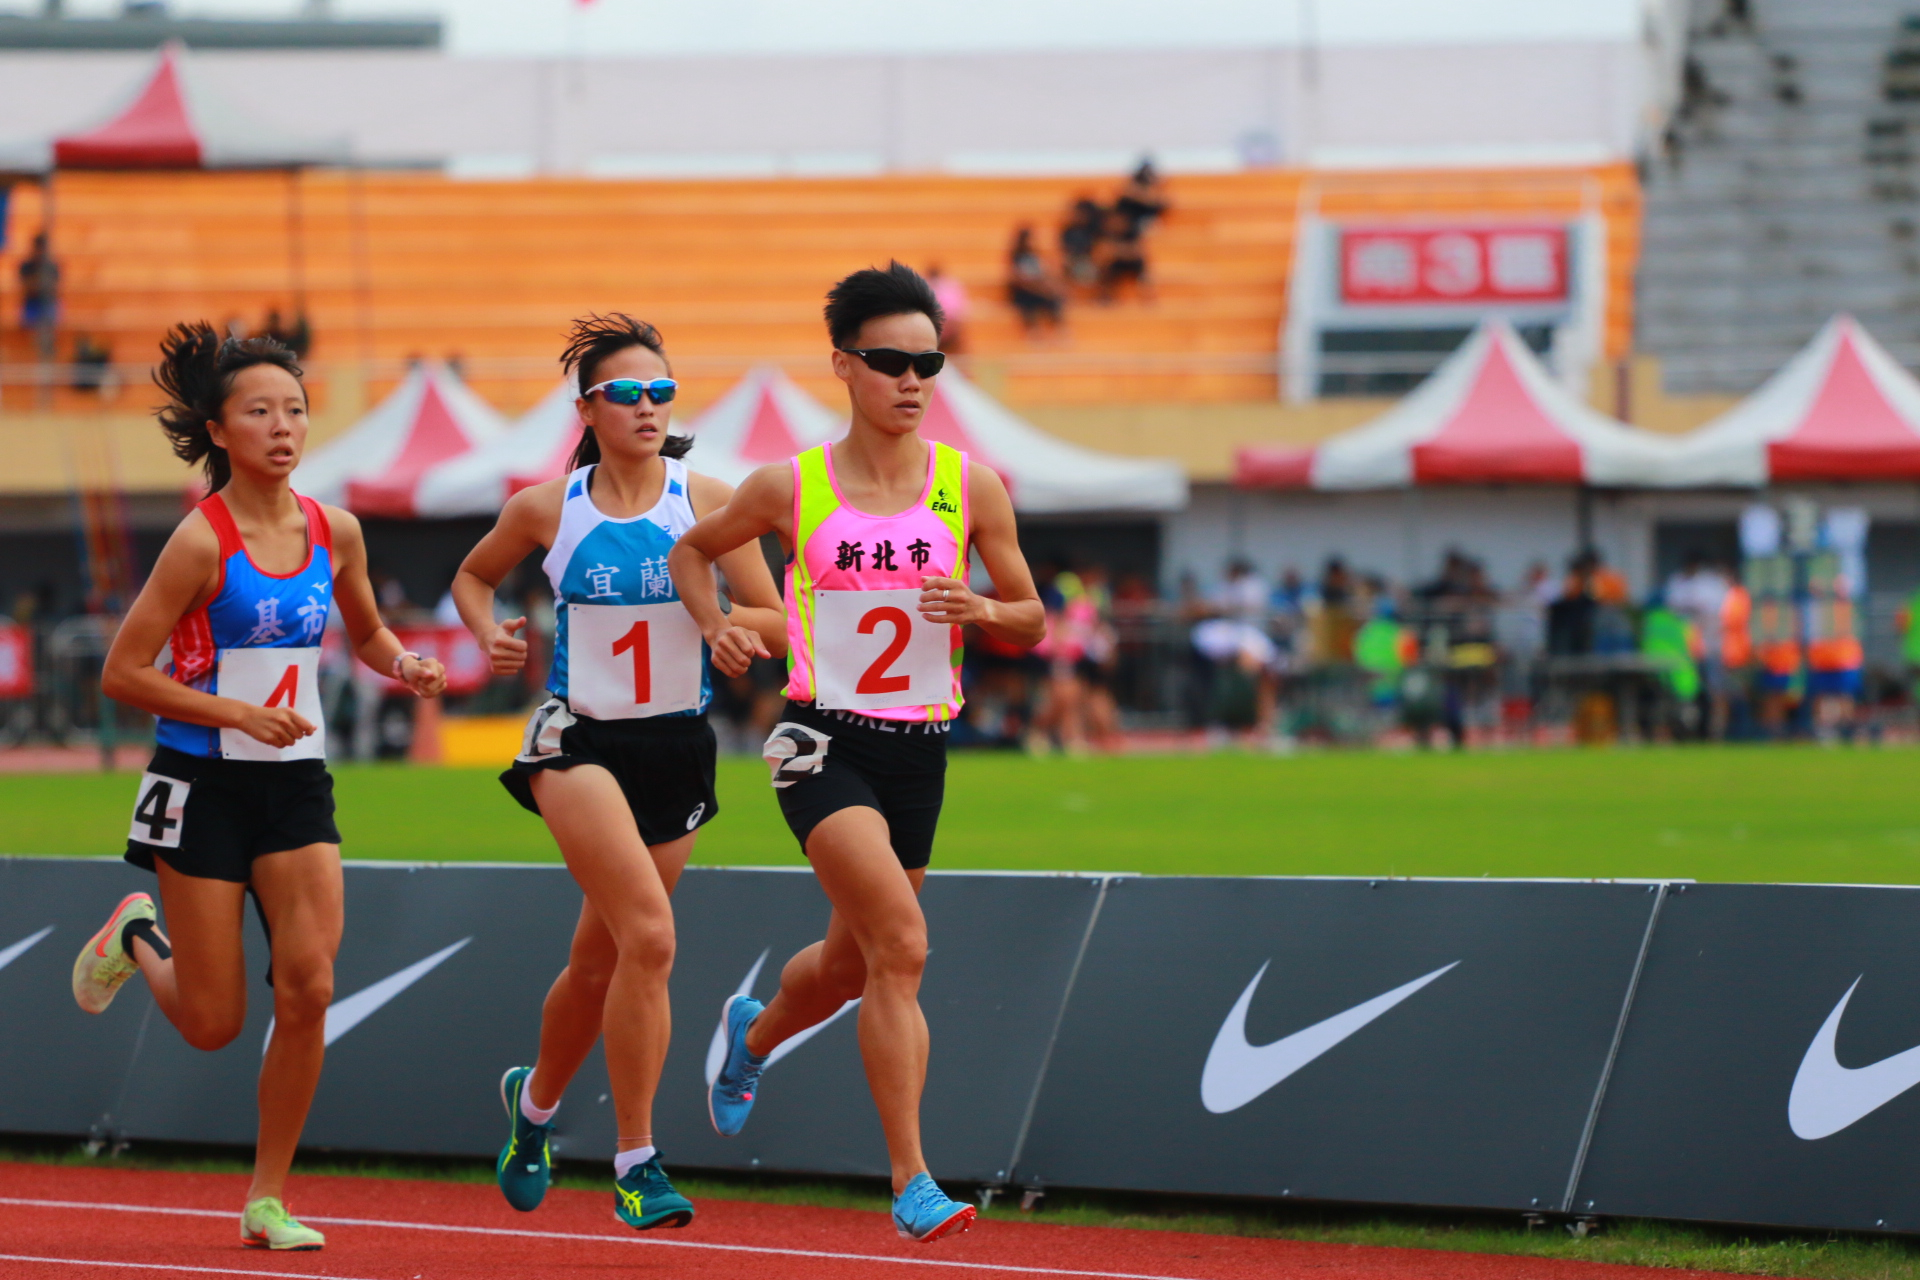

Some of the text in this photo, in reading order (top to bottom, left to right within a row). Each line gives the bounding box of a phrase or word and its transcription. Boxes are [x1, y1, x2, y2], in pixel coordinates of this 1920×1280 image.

[584, 555, 674, 599] 宜蘭
[834, 538, 932, 571] 新北市
[243, 596, 329, 646] 基市
[612, 620, 651, 705] 1
[855, 606, 912, 695] 2
[773, 728, 818, 783] 2
[135, 780, 177, 841] 4
